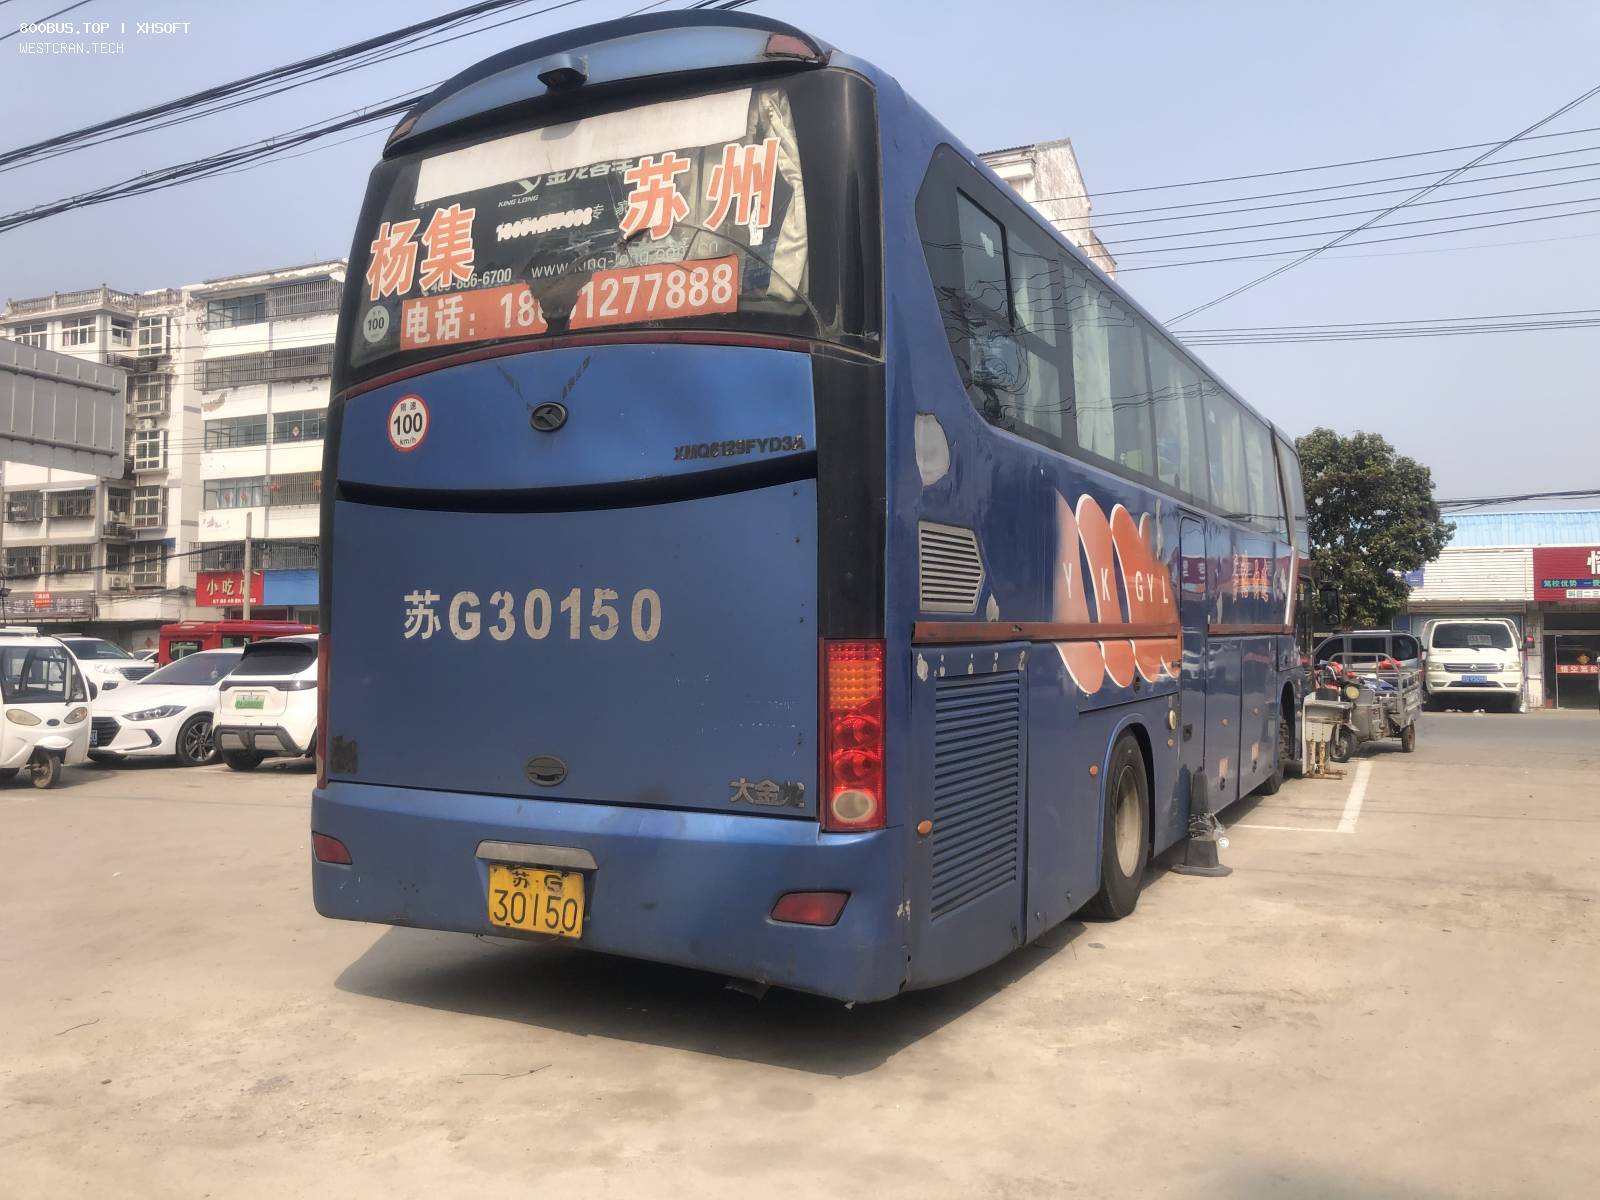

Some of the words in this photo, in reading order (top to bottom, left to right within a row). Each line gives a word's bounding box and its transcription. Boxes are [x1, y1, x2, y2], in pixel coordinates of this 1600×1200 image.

[498, 199, 516, 208] KING
[366, 203, 476, 301] 杨集
[619, 137, 781, 241] 苏州
[500, 263, 733, 329] 181277888
[367, 317, 385, 331] 100
[400, 401, 417, 412] 限速
[393, 412, 423, 435] 100
[399, 437, 417, 445] km/h
[403, 587, 663, 642] 苏G30150
[493, 889, 578, 932] 30150
